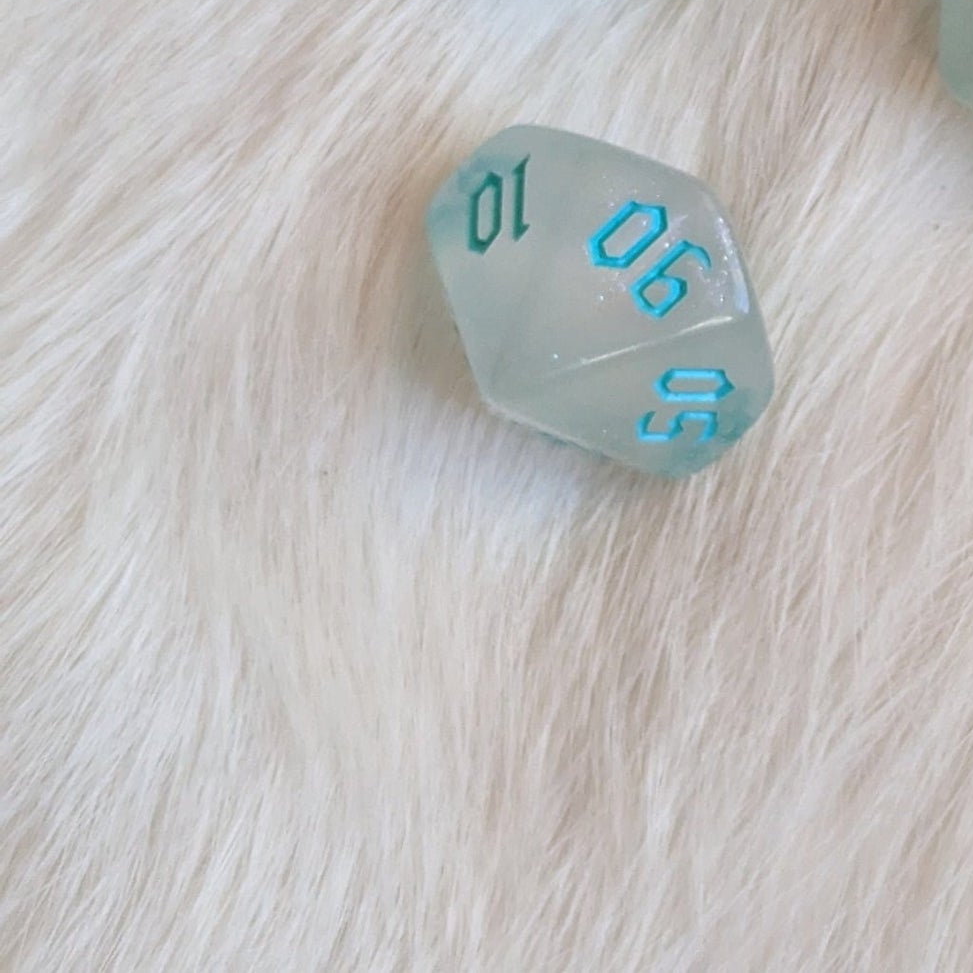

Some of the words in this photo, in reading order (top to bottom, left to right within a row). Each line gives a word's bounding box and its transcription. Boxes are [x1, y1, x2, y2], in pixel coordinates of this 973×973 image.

[465, 153, 531, 256] 10
[585, 199, 713, 320] 90
[634, 366, 740, 448] 50
